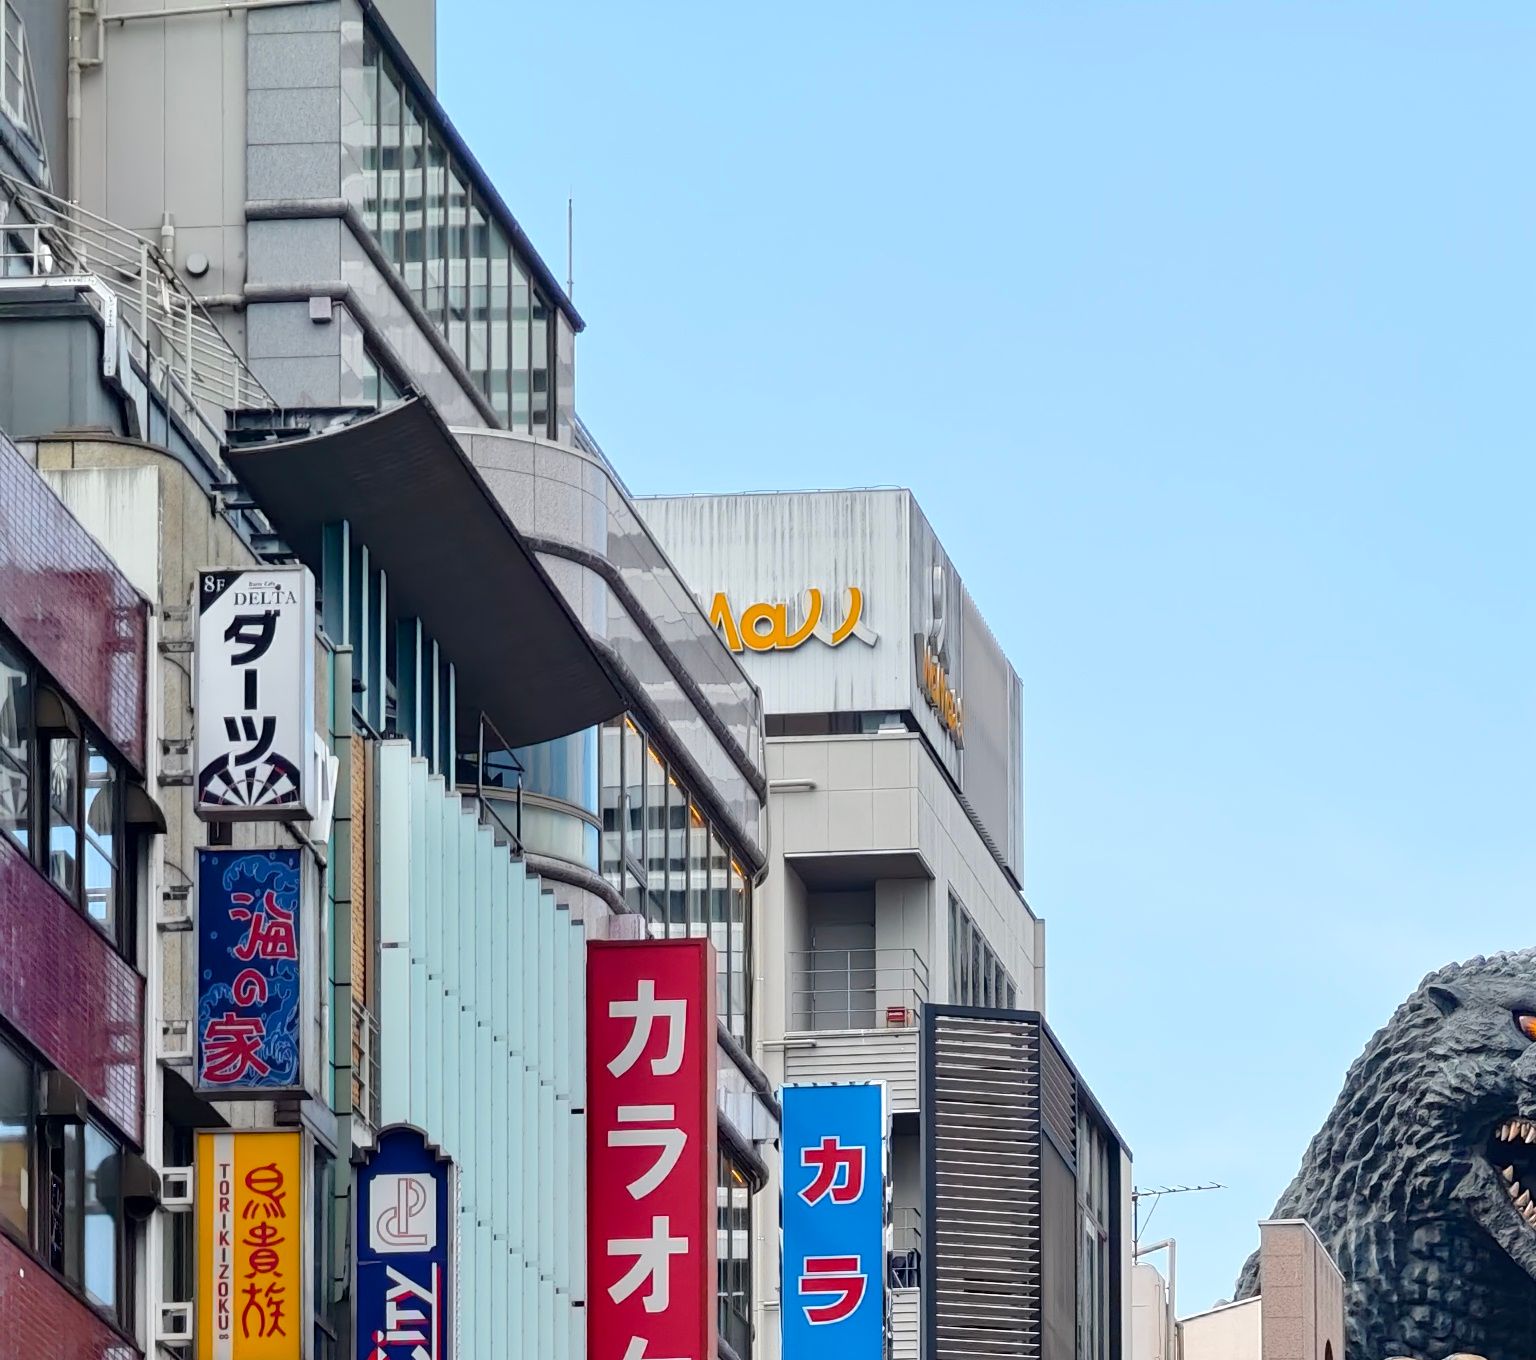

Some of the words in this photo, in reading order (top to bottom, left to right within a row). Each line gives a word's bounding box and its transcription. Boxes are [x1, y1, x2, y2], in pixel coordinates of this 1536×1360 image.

[203, 575, 227, 593] 8F
[233, 590, 297, 606] DELTA
[223, 609, 281, 767] ダーツ
[204, 890, 297, 1085] 海の家
[218, 1163, 231, 1331] TORIKIZOKU
